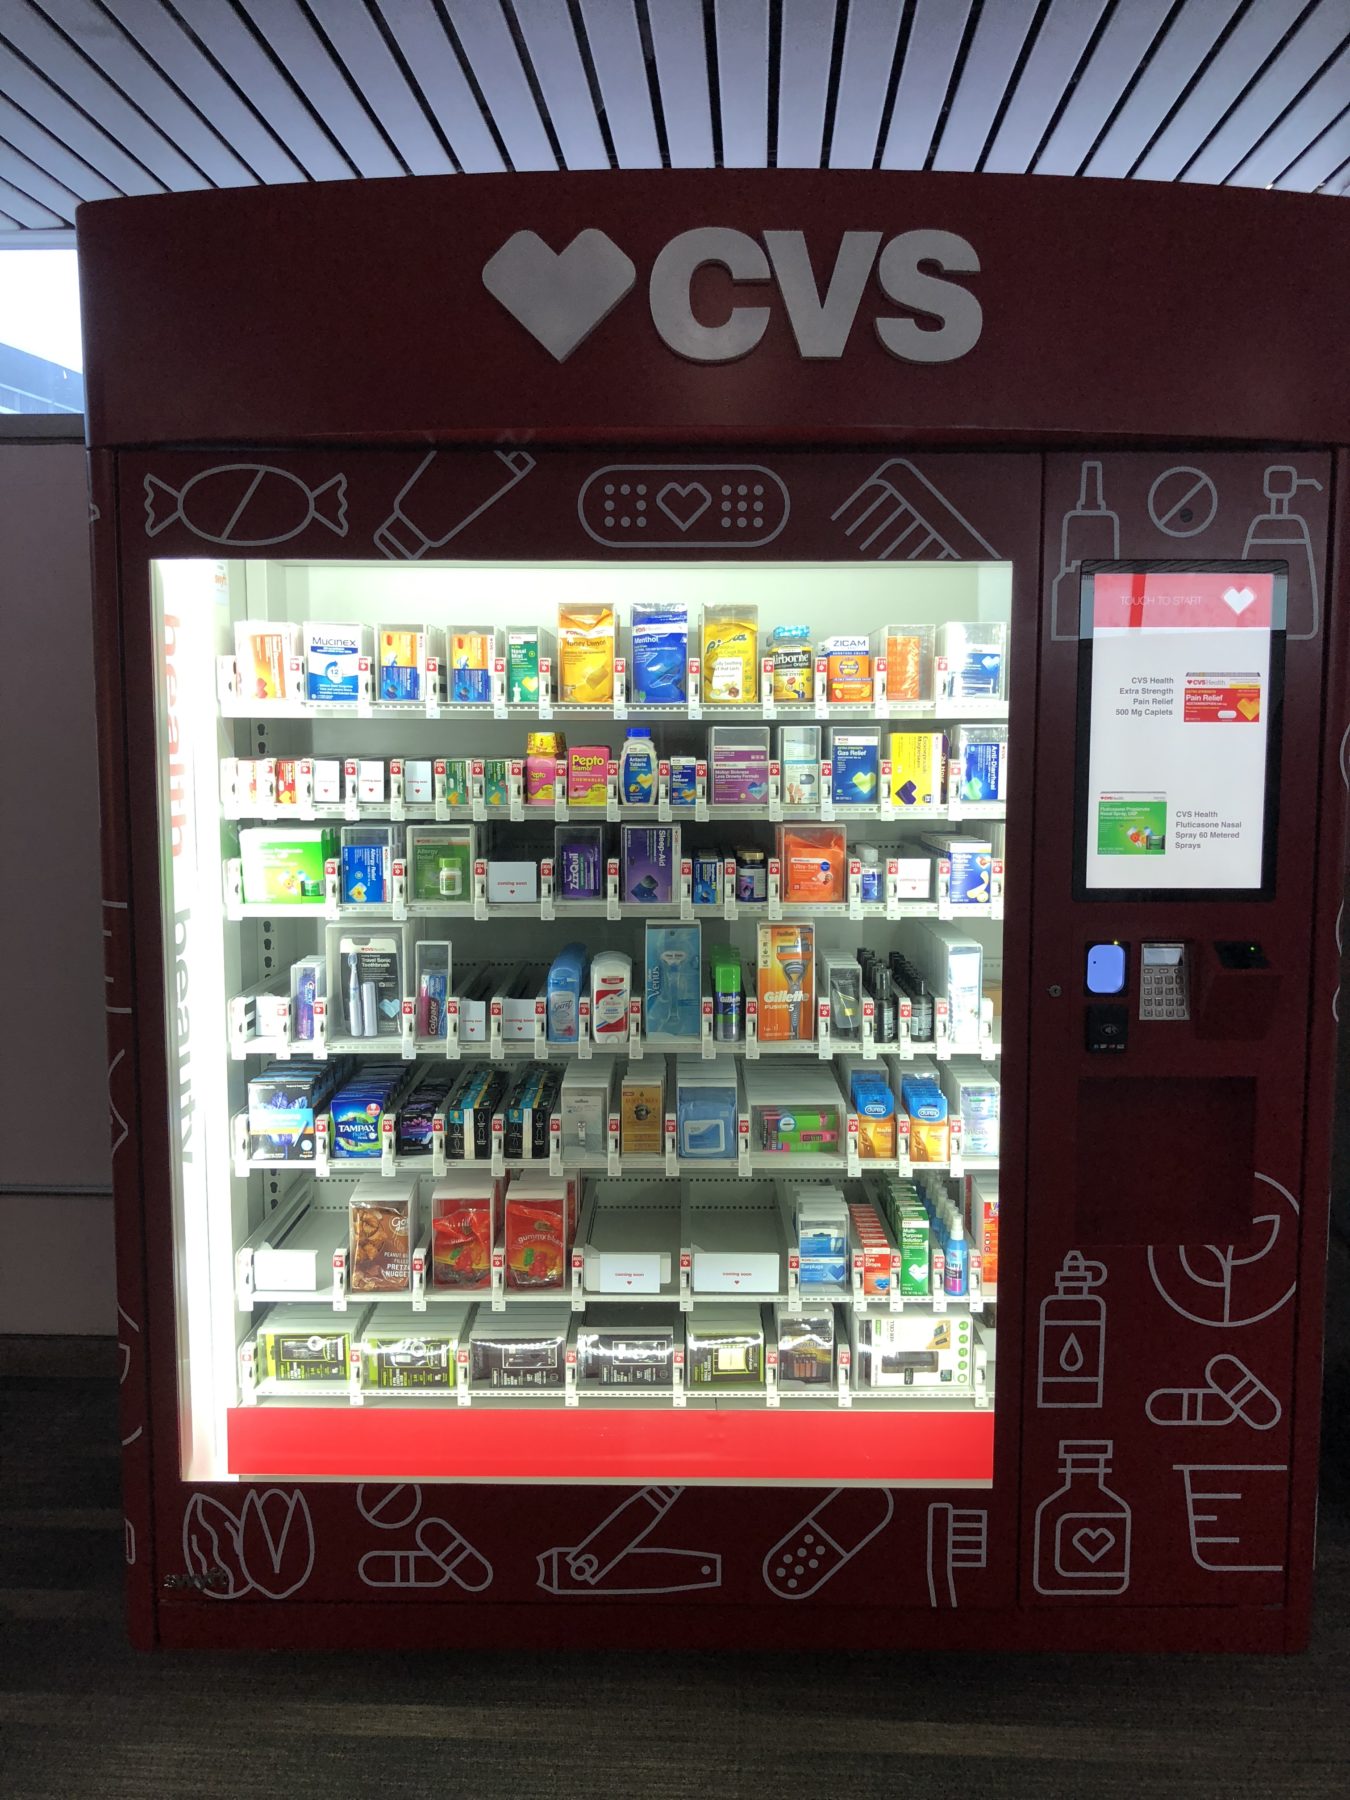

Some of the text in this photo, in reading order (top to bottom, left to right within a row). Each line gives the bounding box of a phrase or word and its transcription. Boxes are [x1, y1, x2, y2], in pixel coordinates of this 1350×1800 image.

[649, 226, 984, 365] CVS
[1120, 596, 1202, 606] TOUCH TO START
[312, 636, 356, 647] Mucinex
[833, 639, 866, 647] ZICAM
[1131, 677, 1174, 685] CVS Health
[1119, 687, 1174, 697] Extra Strength
[1132, 698, 1174, 706] Pain Relief
[1185, 694, 1224, 702] Pain Relief
[1115, 708, 1173, 718] 500 Mg Caplets
[571, 754, 605, 769] Pepto
[1175, 821, 1242, 829] Fluticasone Nasal
[1175, 832, 1197, 840] Spray
[658, 829, 666, 867] Sleep-Aid
[1175, 842, 1201, 850] Sprays
[569, 852, 579, 890] ZzzQuil
[648, 965, 660, 998] Venus
[763, 990, 810, 1003] Gillette
[428, 1001, 437, 1035] Colgate
[174, 907, 196, 1167] beauty
[919, 1109, 938, 1117] durex
[338, 1125, 375, 1133] TAMPAX
